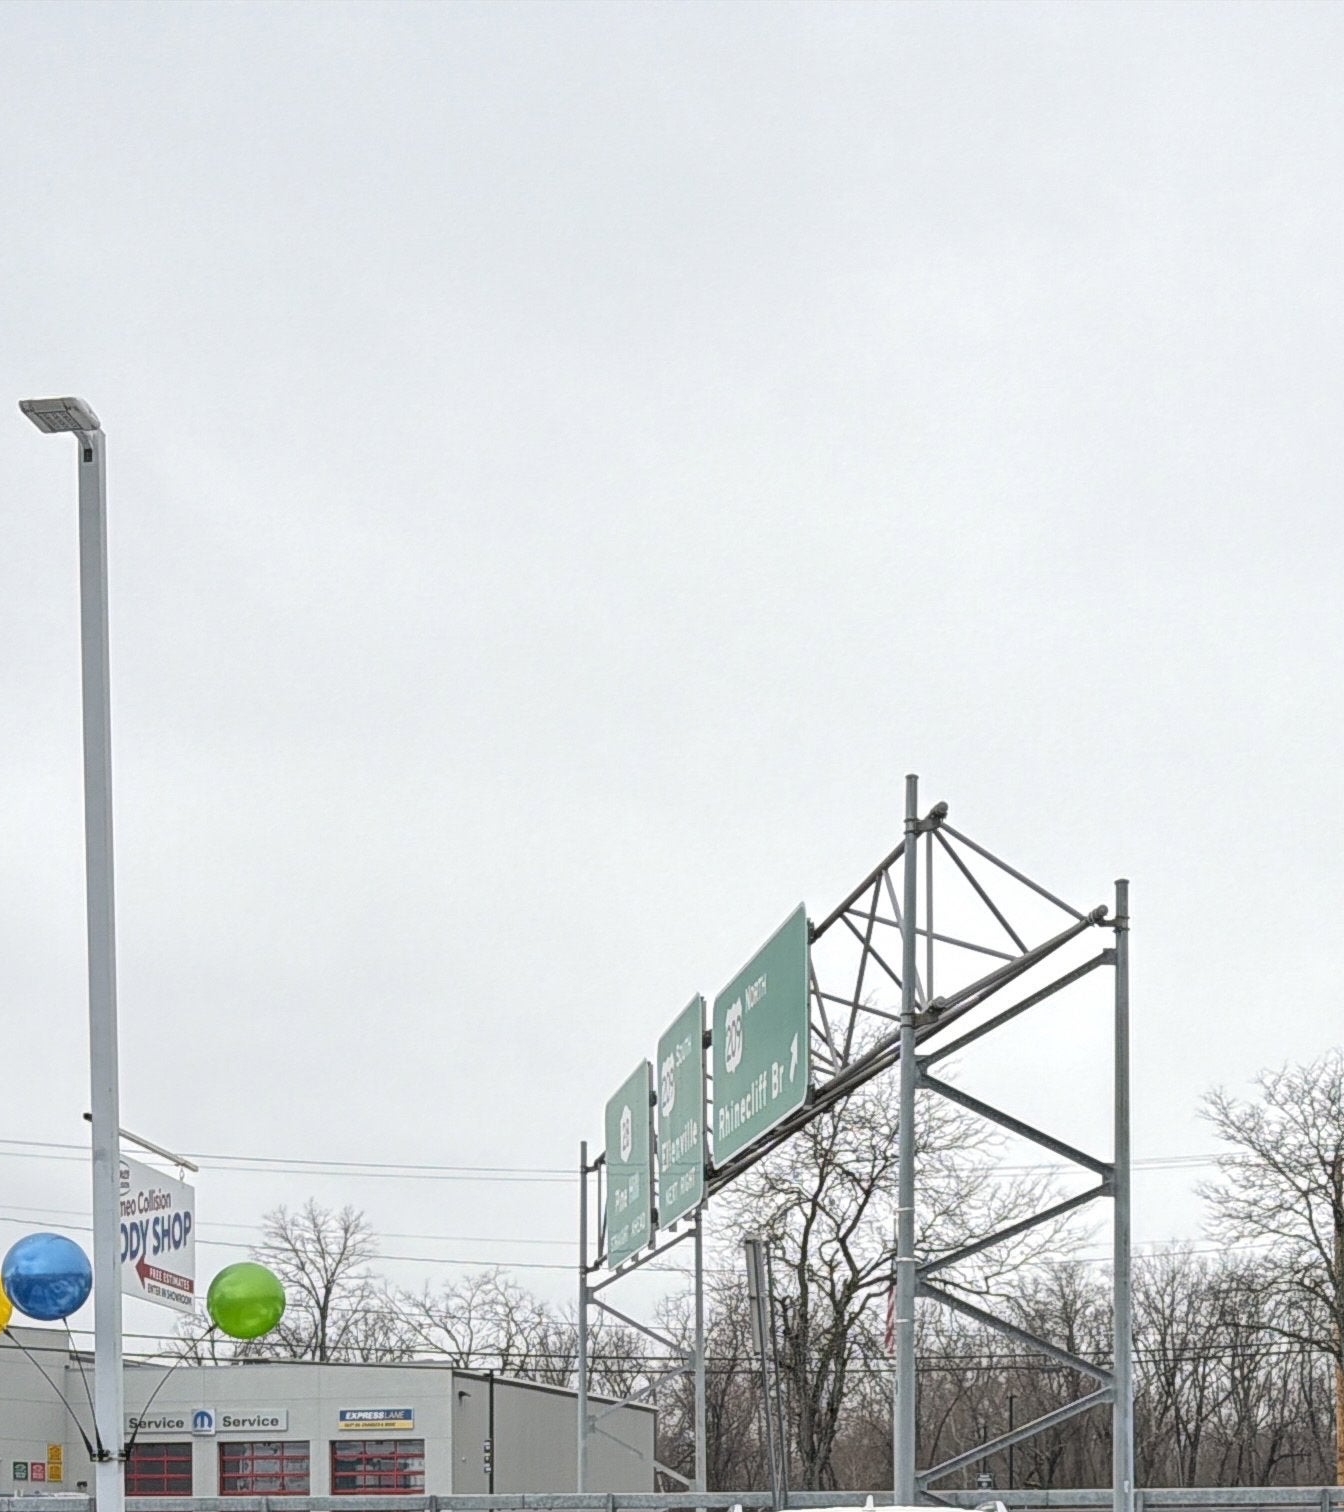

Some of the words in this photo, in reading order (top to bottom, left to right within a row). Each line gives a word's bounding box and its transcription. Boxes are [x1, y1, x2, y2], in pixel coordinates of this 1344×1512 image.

[719, 1070, 767, 1141] Rhinecliff
[771, 1061, 784, 1099] Br
[138, 1188, 172, 1214] Collision
[121, 1218, 149, 1264] ODY
[152, 1210, 192, 1256] SHOP
[129, 1417, 184, 1429] Service
[222, 1415, 279, 1428] Service
